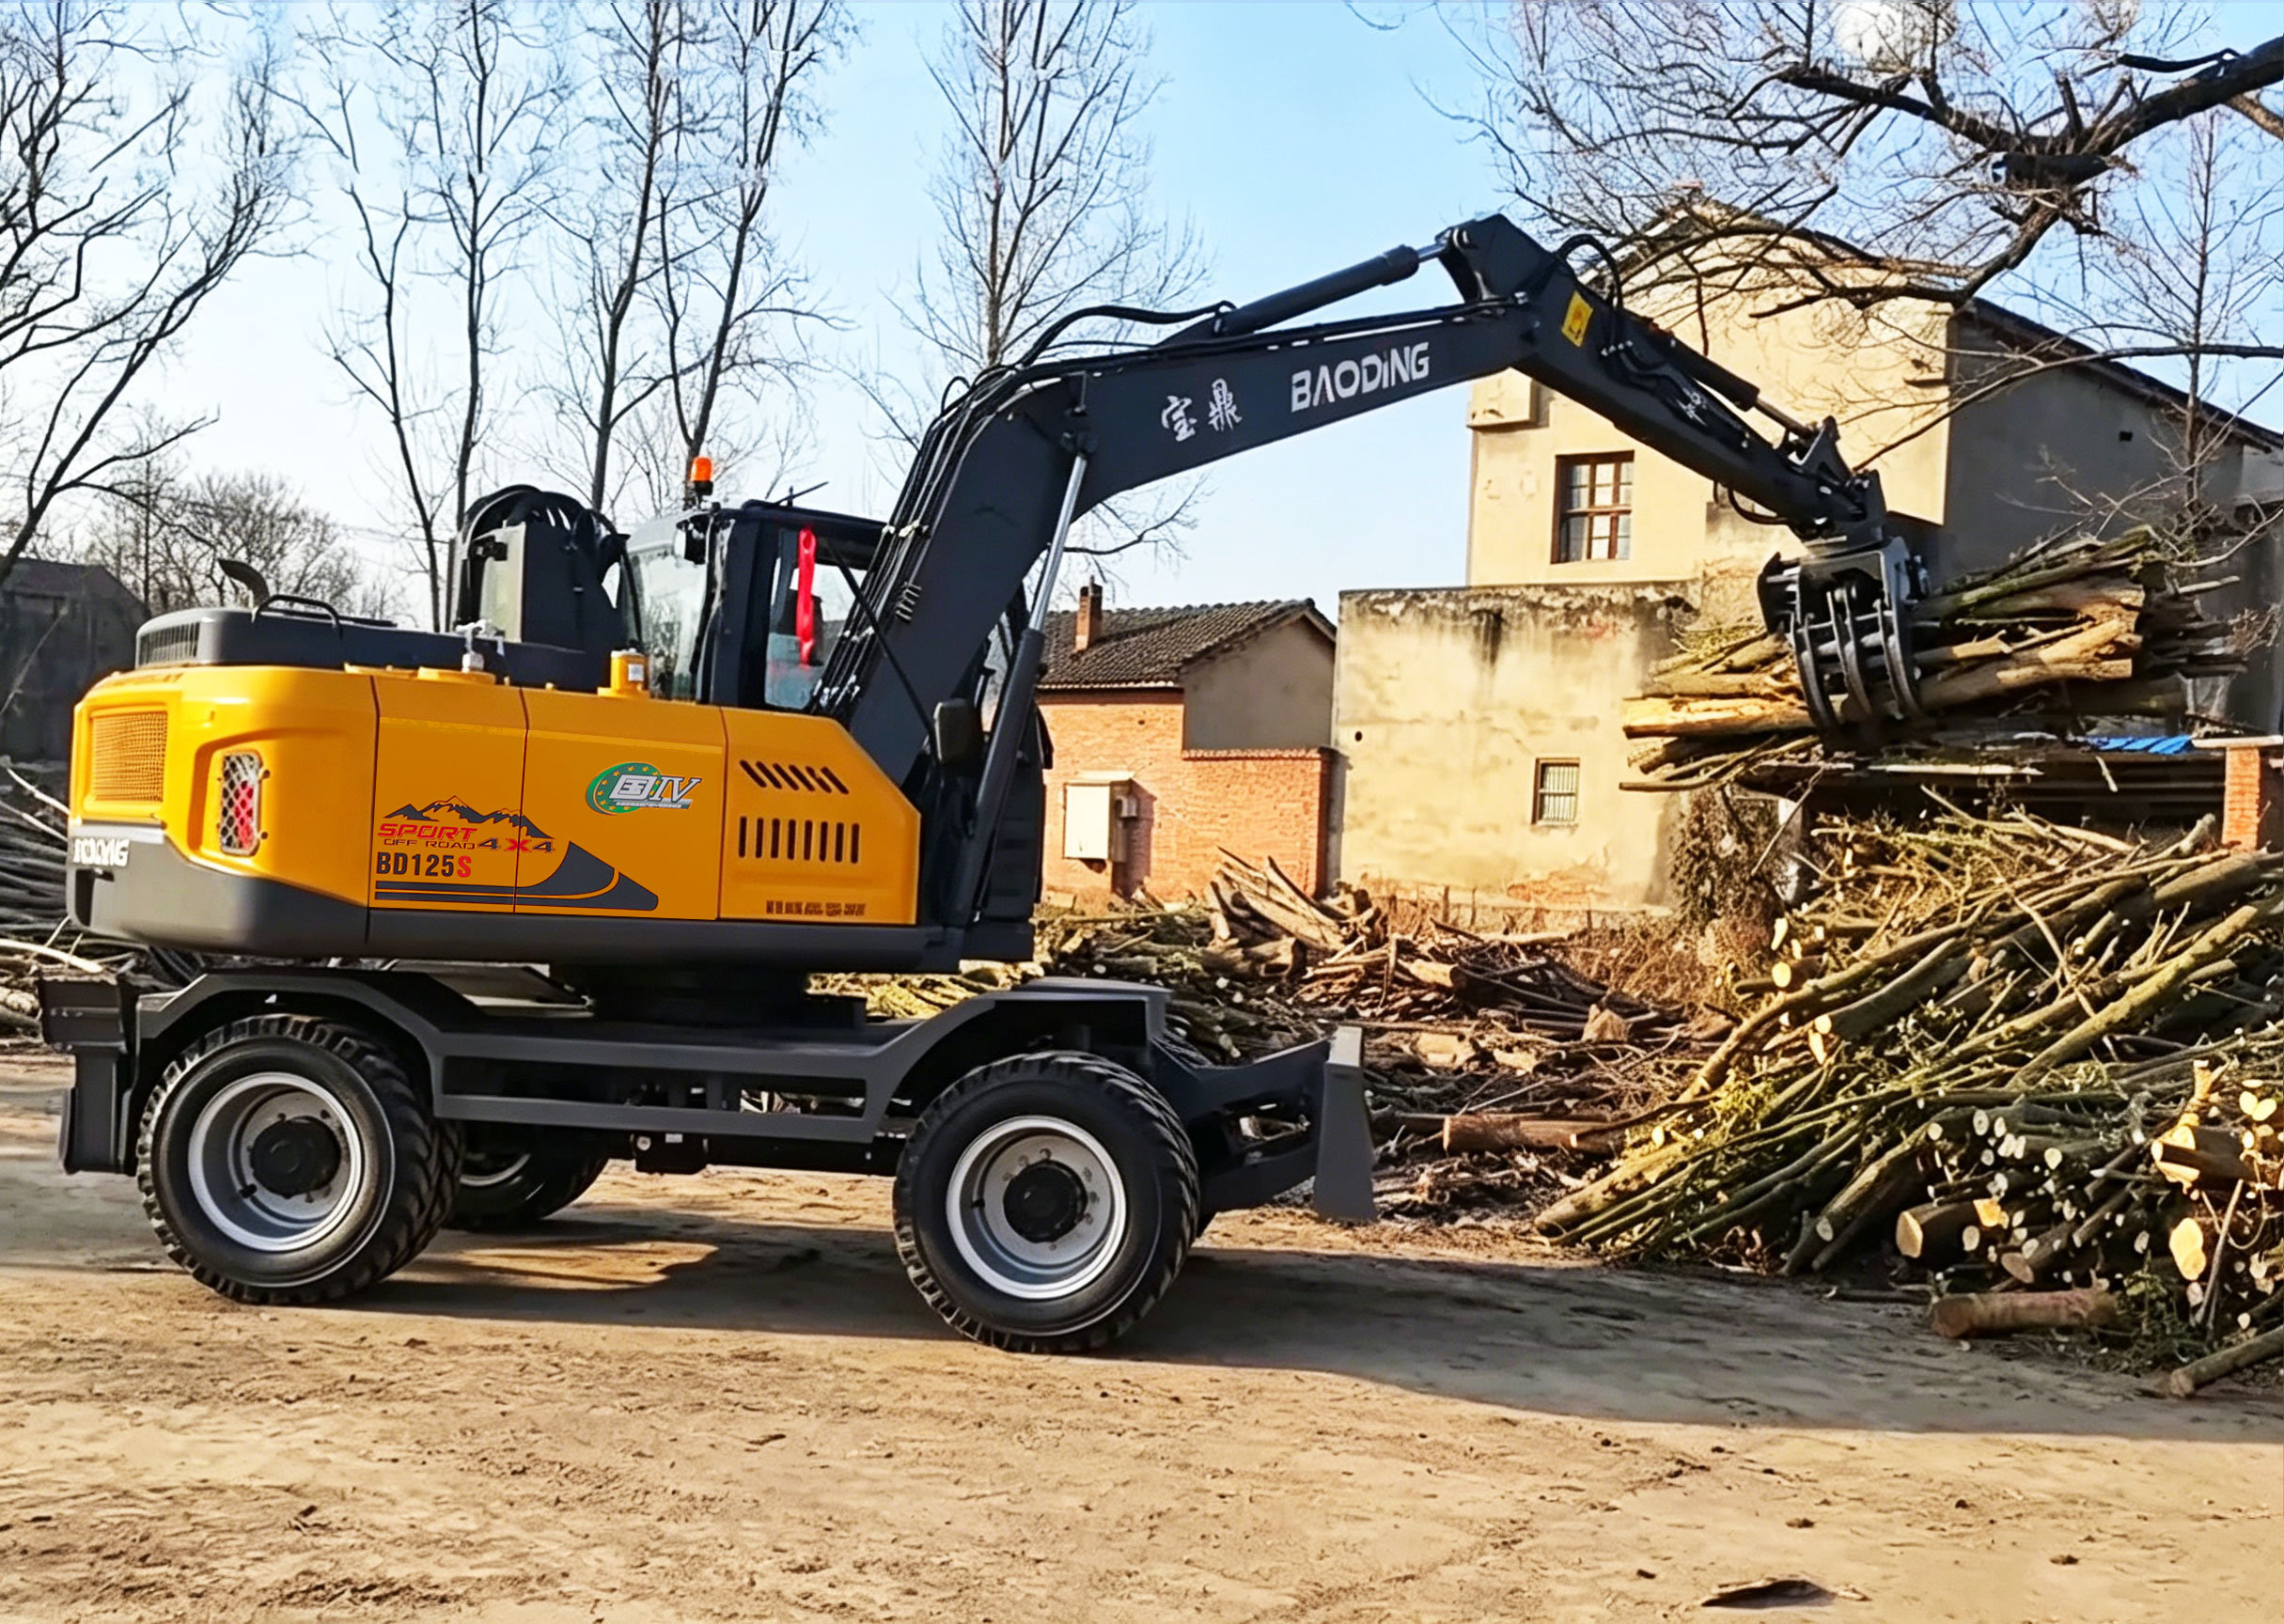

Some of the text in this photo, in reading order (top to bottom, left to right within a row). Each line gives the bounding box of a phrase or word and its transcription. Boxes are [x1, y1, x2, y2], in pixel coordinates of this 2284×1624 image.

[1291, 342, 1430, 413] BAODING
[1162, 379, 1242, 442] 宝鼎
[378, 823, 477, 841] SPORT
[383, 838, 418, 847] OFF
[425, 840, 476, 850] ROAD
[377, 851, 472, 878] BD125S
